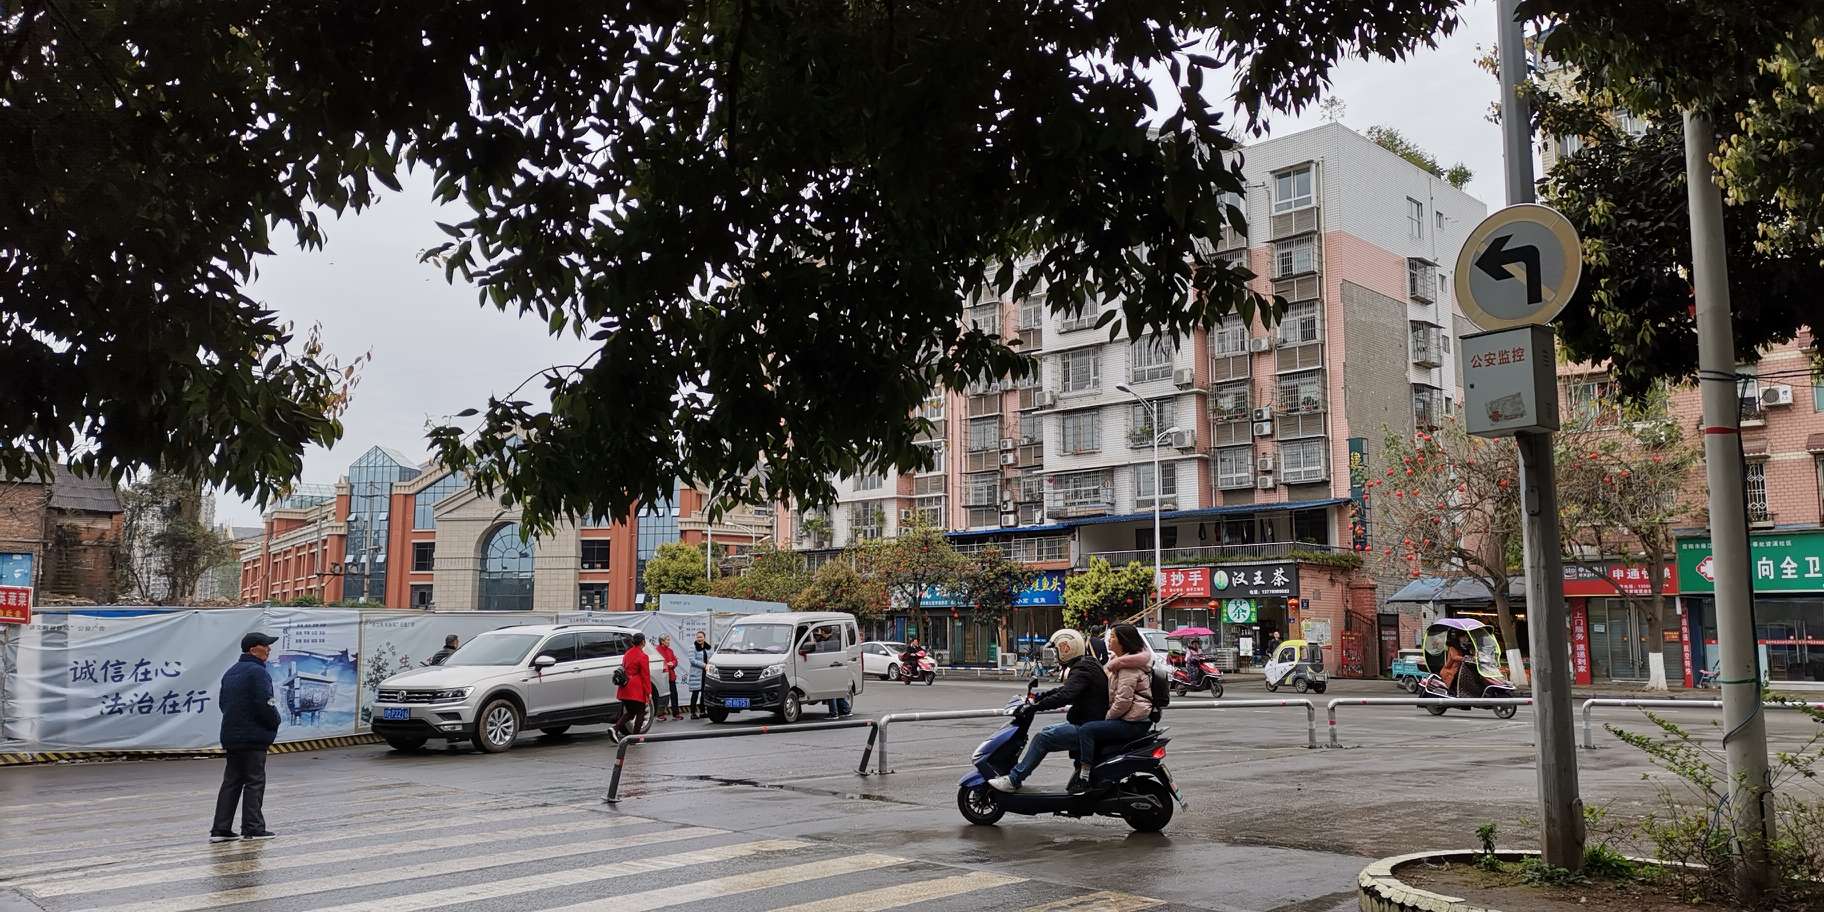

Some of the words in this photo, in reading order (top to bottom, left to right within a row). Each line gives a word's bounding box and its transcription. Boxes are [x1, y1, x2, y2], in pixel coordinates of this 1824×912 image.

[1470, 346, 1526, 369] 公安监控
[1232, 567, 1290, 587] 汉王茶
[1757, 556, 1823, 580] 向全卫
[1231, 600, 1247, 619] 茶
[70, 657, 182, 684] 诚信在心
[99, 689, 211, 716] 法治在行
